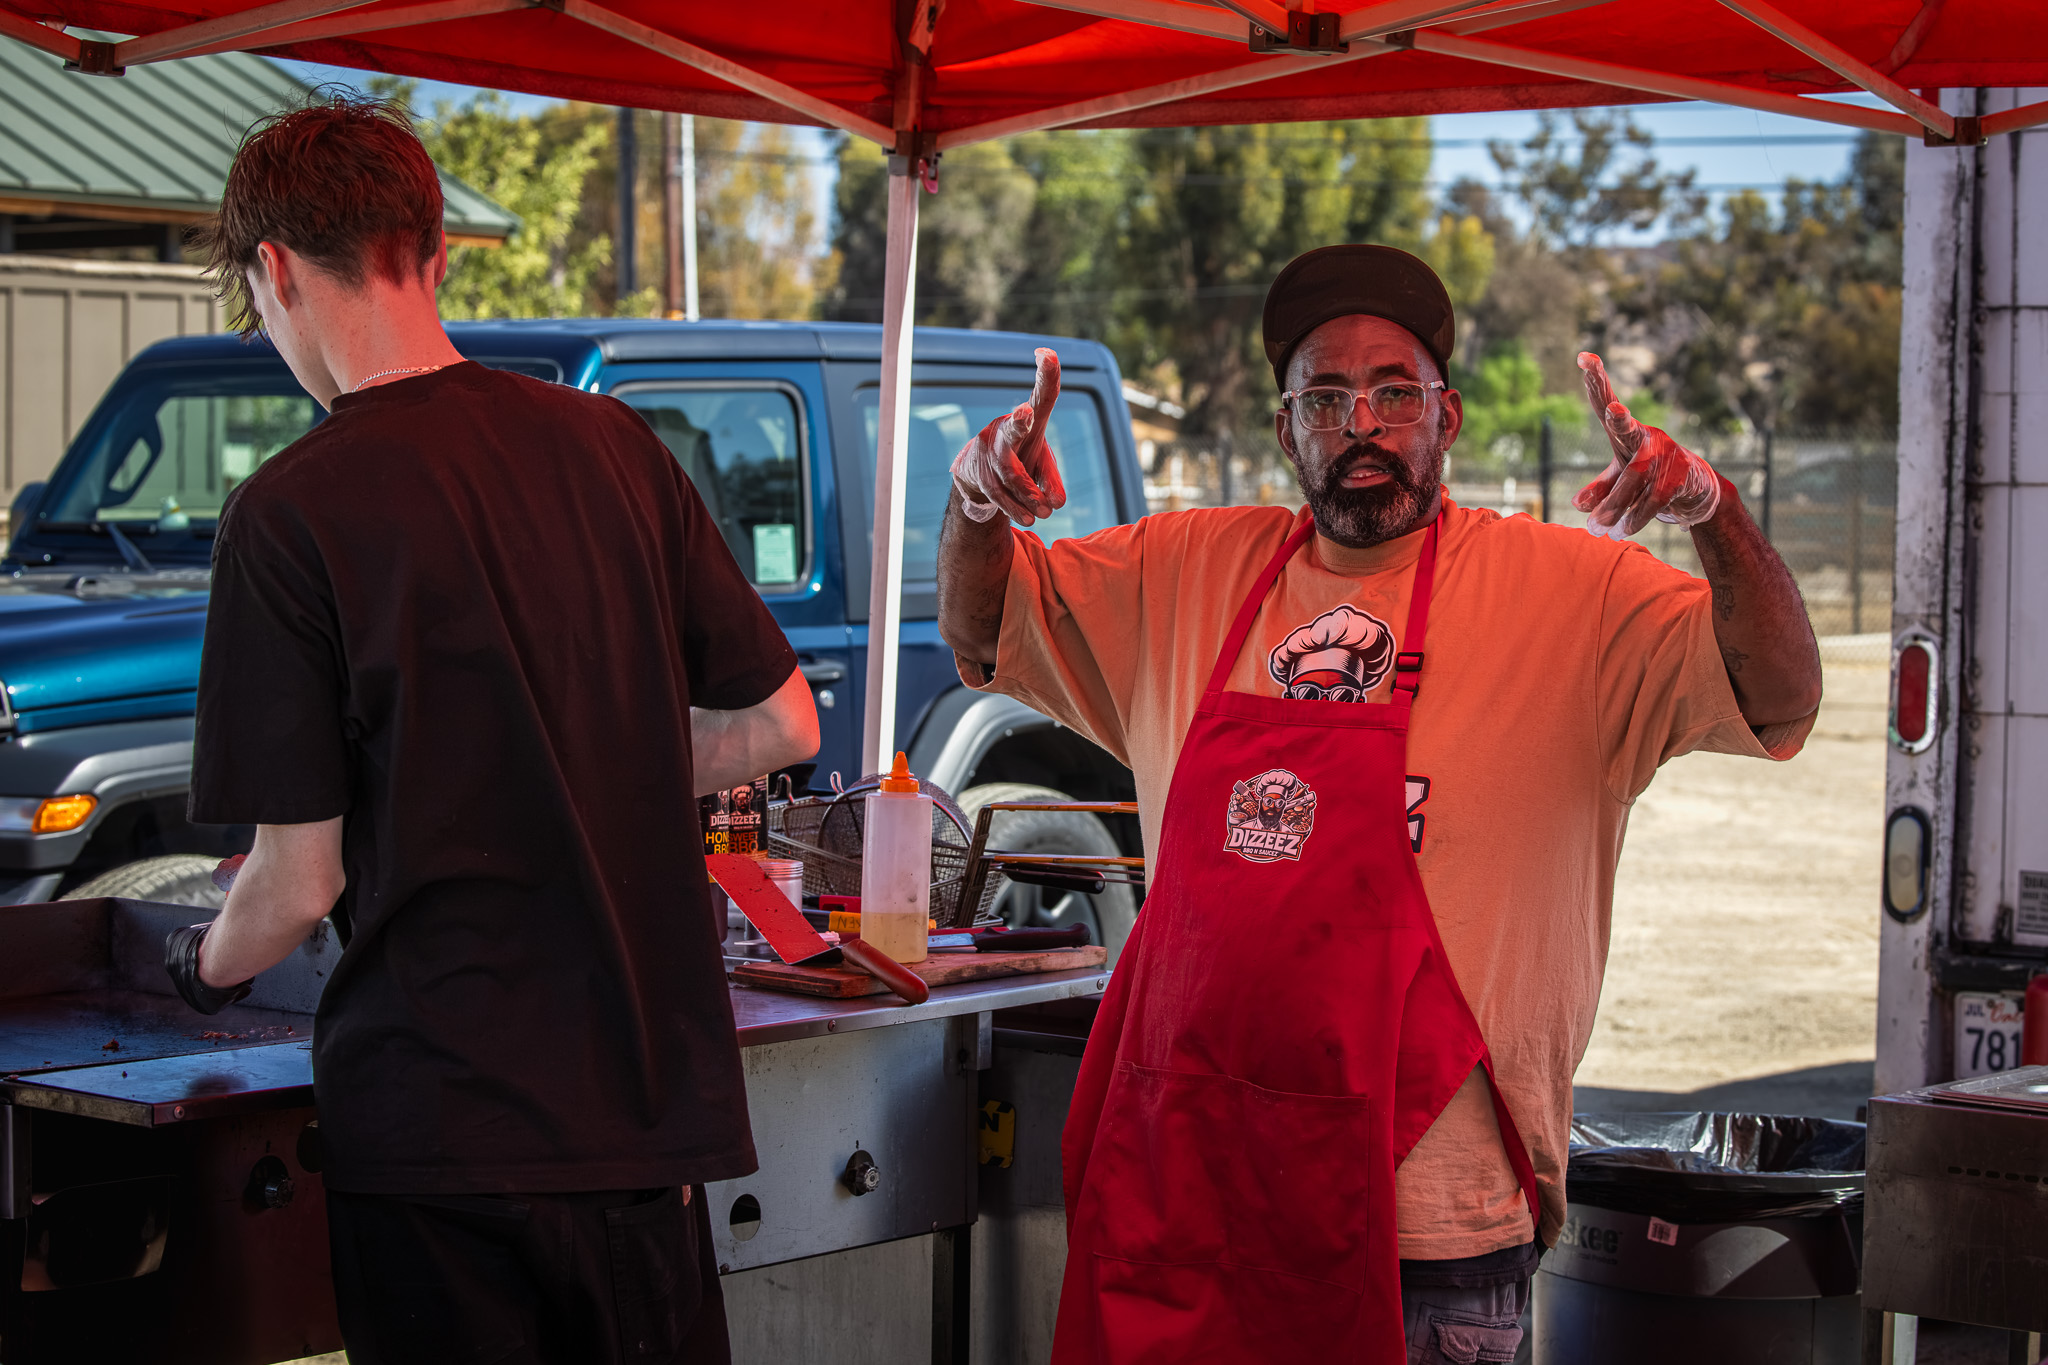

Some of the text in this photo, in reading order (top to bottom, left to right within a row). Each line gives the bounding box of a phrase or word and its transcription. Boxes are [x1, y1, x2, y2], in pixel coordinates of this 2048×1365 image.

[729, 832, 759, 841] SWEET
[1228, 828, 1301, 855] DIZZEEZ
[729, 840, 759, 854] BBQ
